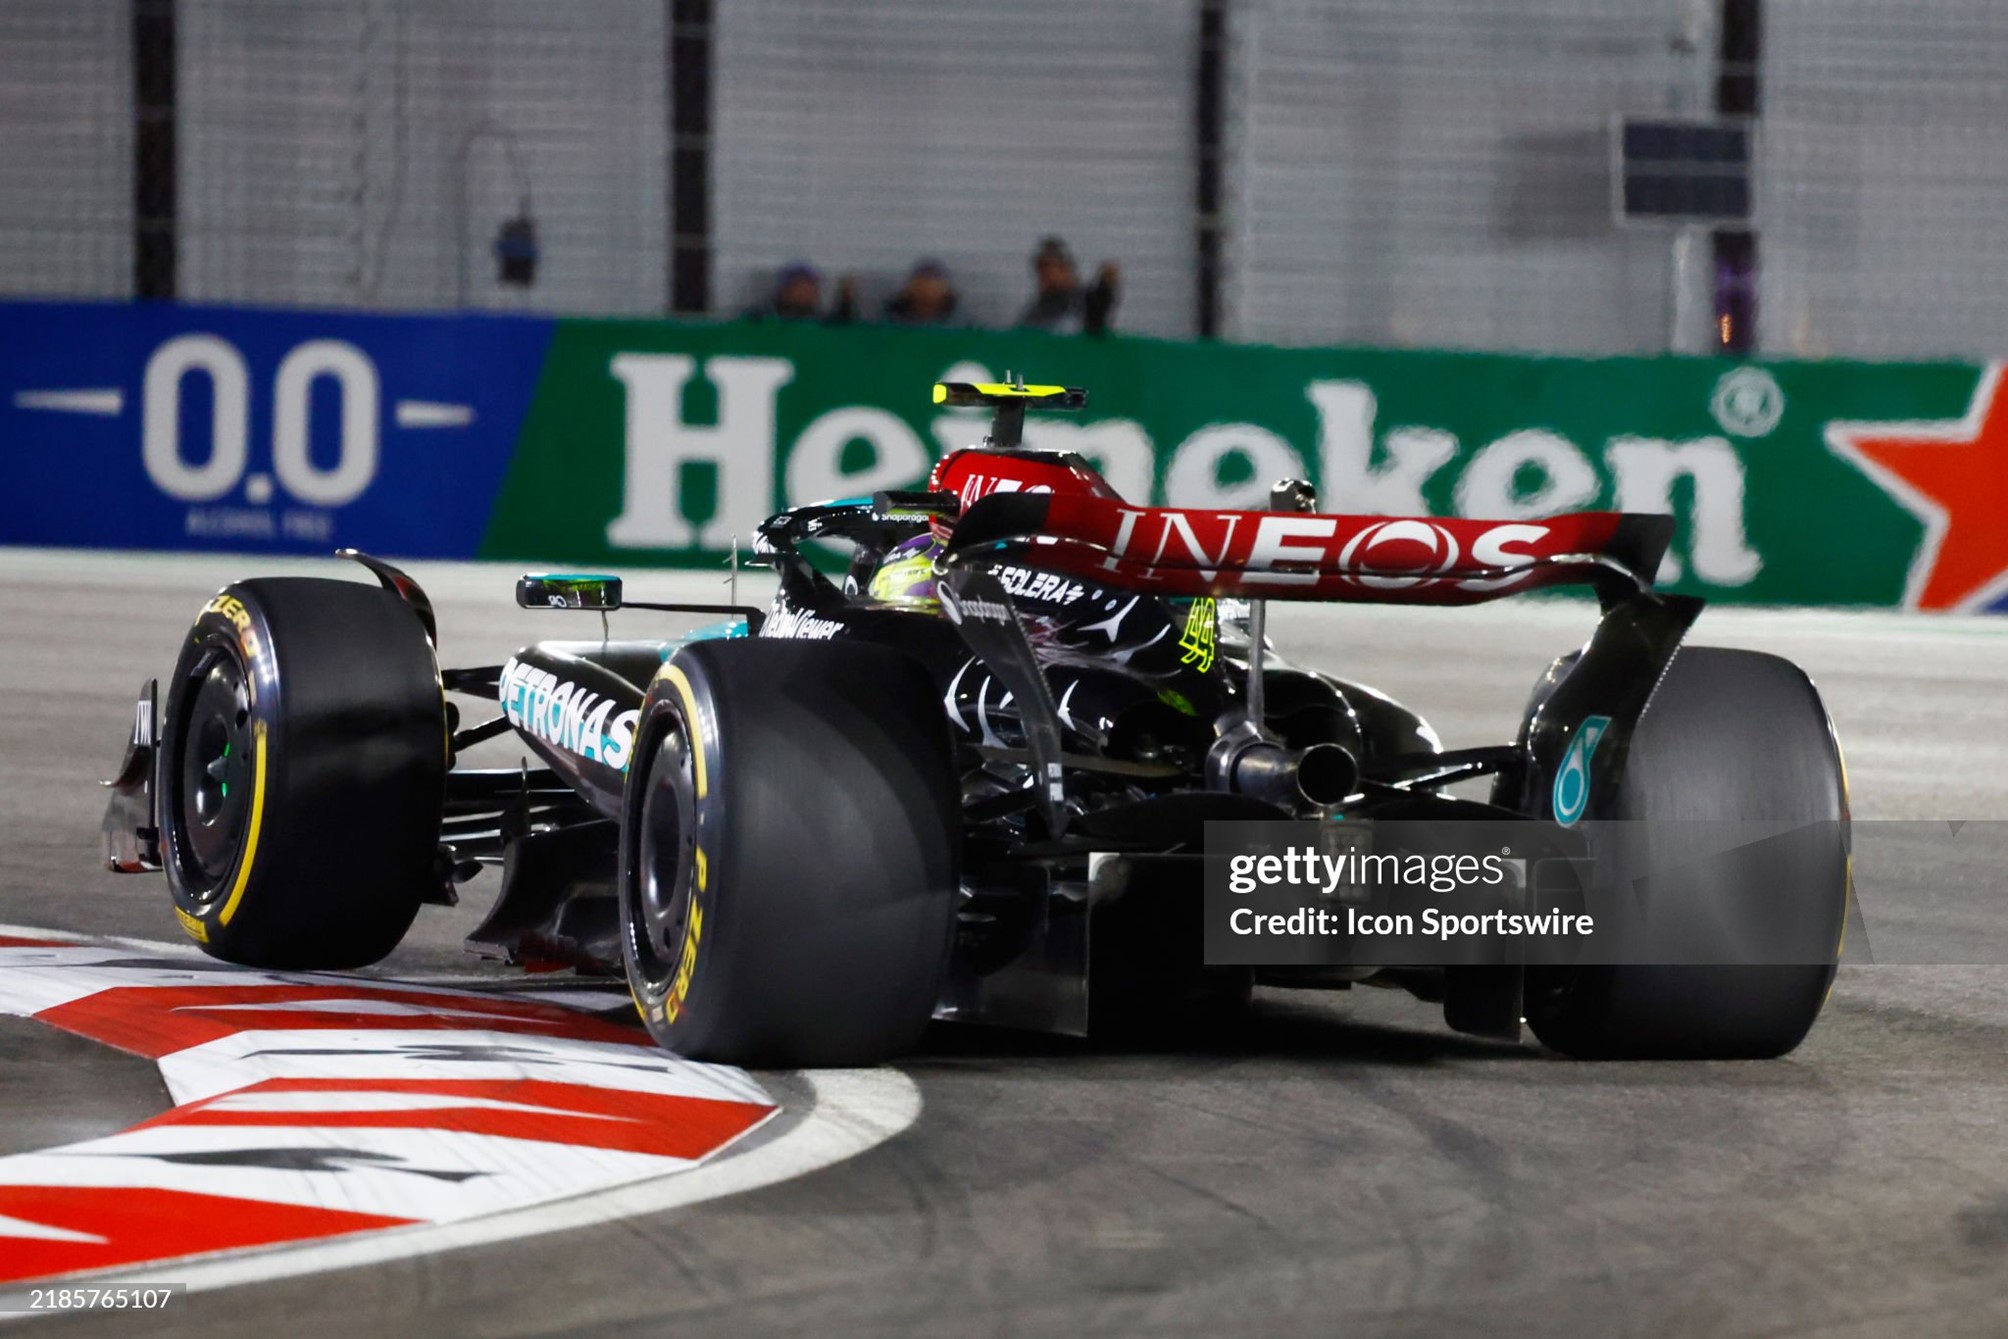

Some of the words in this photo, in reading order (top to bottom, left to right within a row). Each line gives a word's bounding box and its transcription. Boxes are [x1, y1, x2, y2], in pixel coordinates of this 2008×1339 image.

[142, 333, 380, 506] 0.0
[1001, 565, 1070, 604] SOLERA
[1099, 507, 1551, 592] INEOS
[499, 656, 640, 770] PETRONAS
